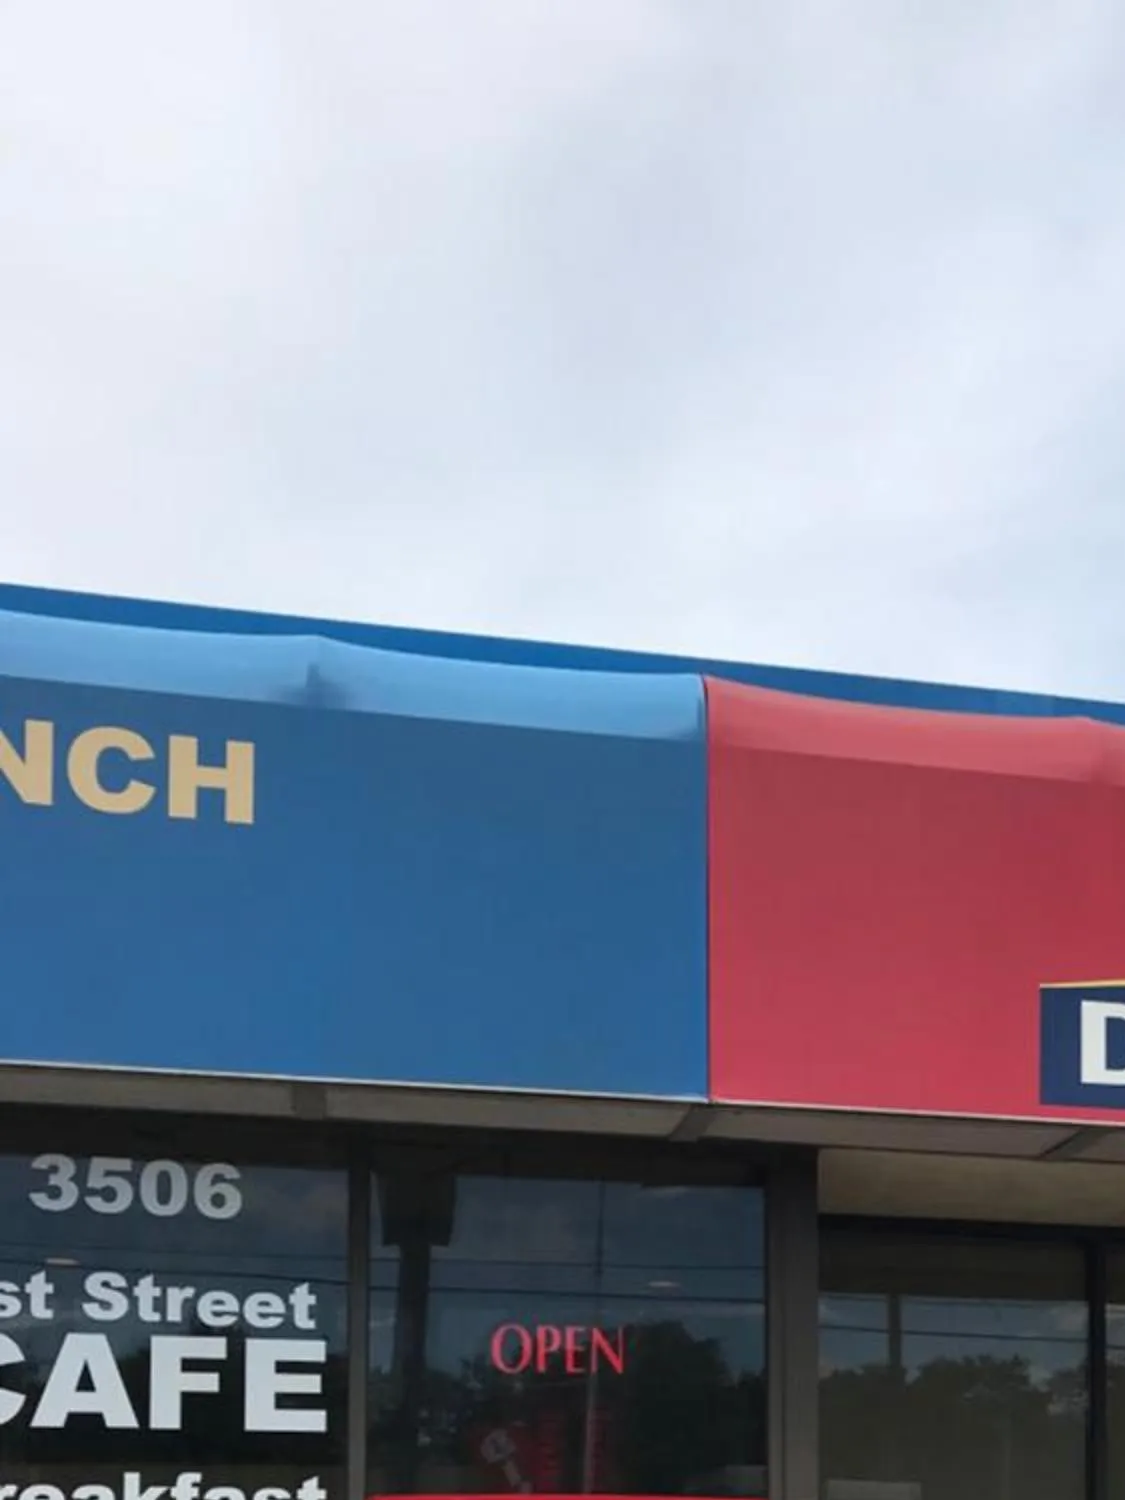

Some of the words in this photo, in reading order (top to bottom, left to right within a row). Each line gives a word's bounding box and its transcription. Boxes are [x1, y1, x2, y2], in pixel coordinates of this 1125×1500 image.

[28, 1153, 243, 1220] 3506
[82, 1271, 317, 1330] Street
[490, 1323, 625, 1376] OPEN
[0, 1332, 328, 1433] AFE
